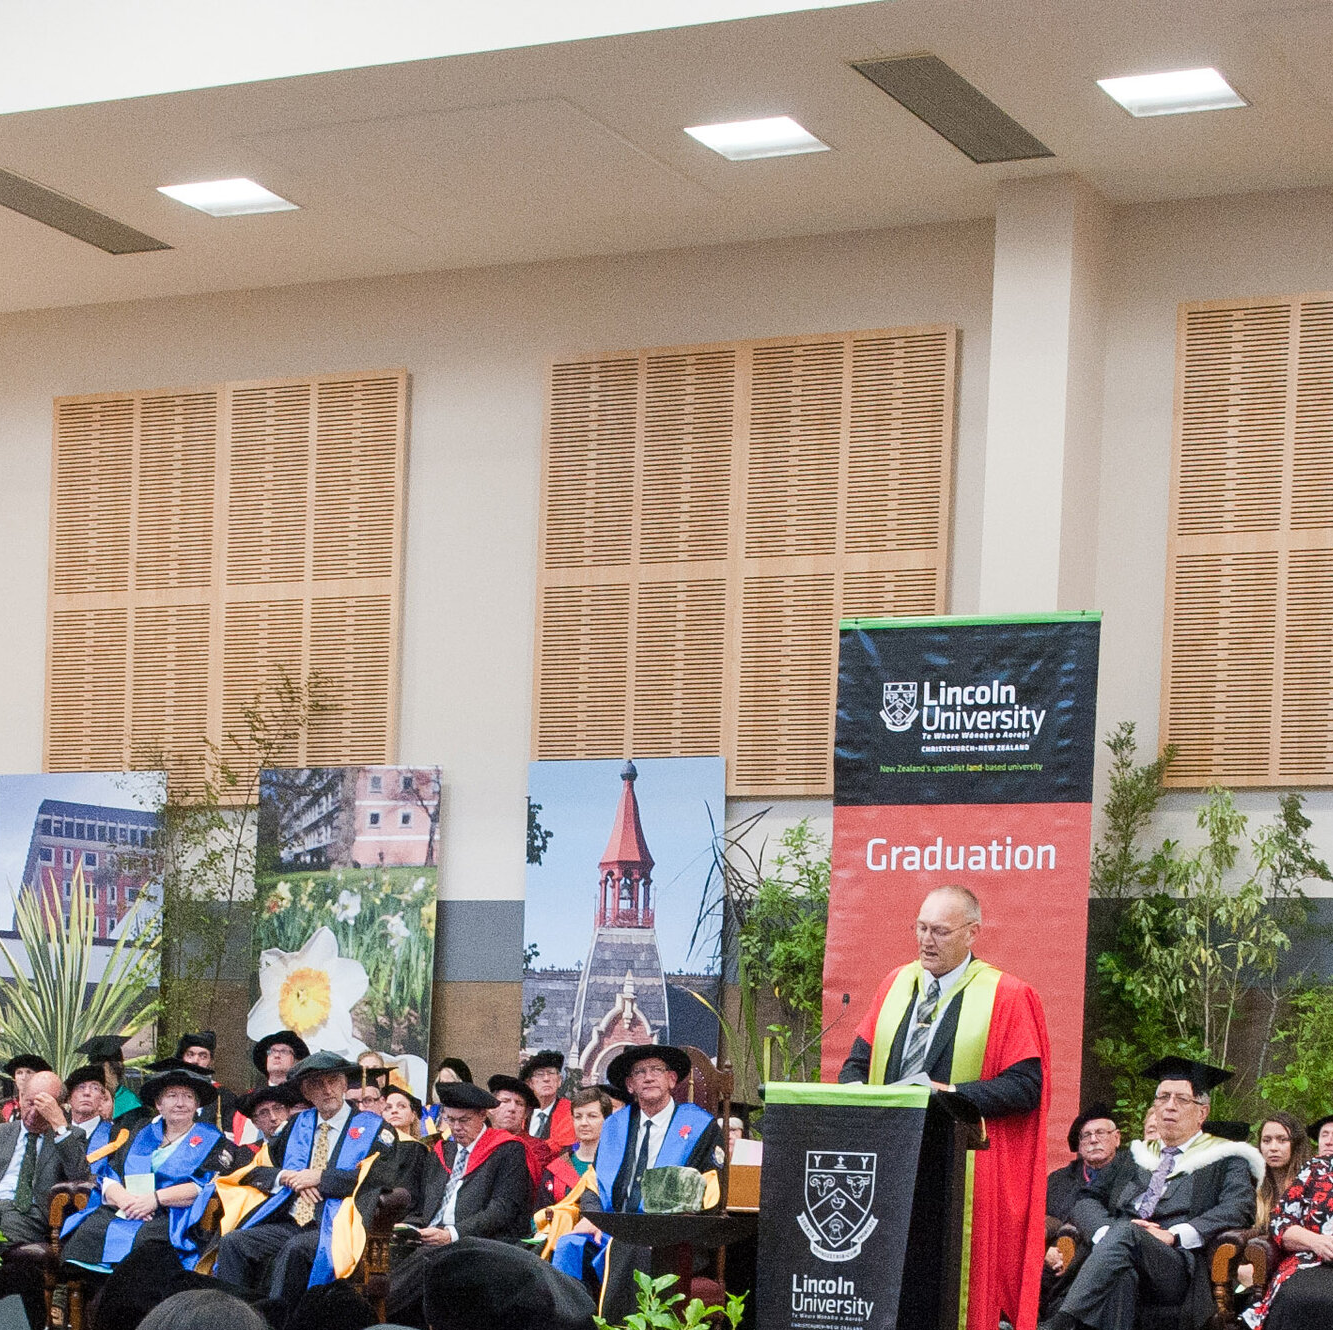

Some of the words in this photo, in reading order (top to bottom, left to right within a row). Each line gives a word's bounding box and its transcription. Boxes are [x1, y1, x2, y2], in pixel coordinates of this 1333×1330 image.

[923, 680, 1015, 705] Lincoln
[922, 704, 1046, 735] University
[922, 732, 932, 740] Te
[996, 743, 1030, 751] ZEALAND
[880, 764, 896, 773] New
[897, 764, 931, 773] Zealand's
[932, 763, 965, 774] specialist
[1007, 762, 1044, 772] university
[866, 836, 1056, 871] Graduation
[792, 1273, 855, 1295] Lincoln
[791, 1292, 874, 1321] University
